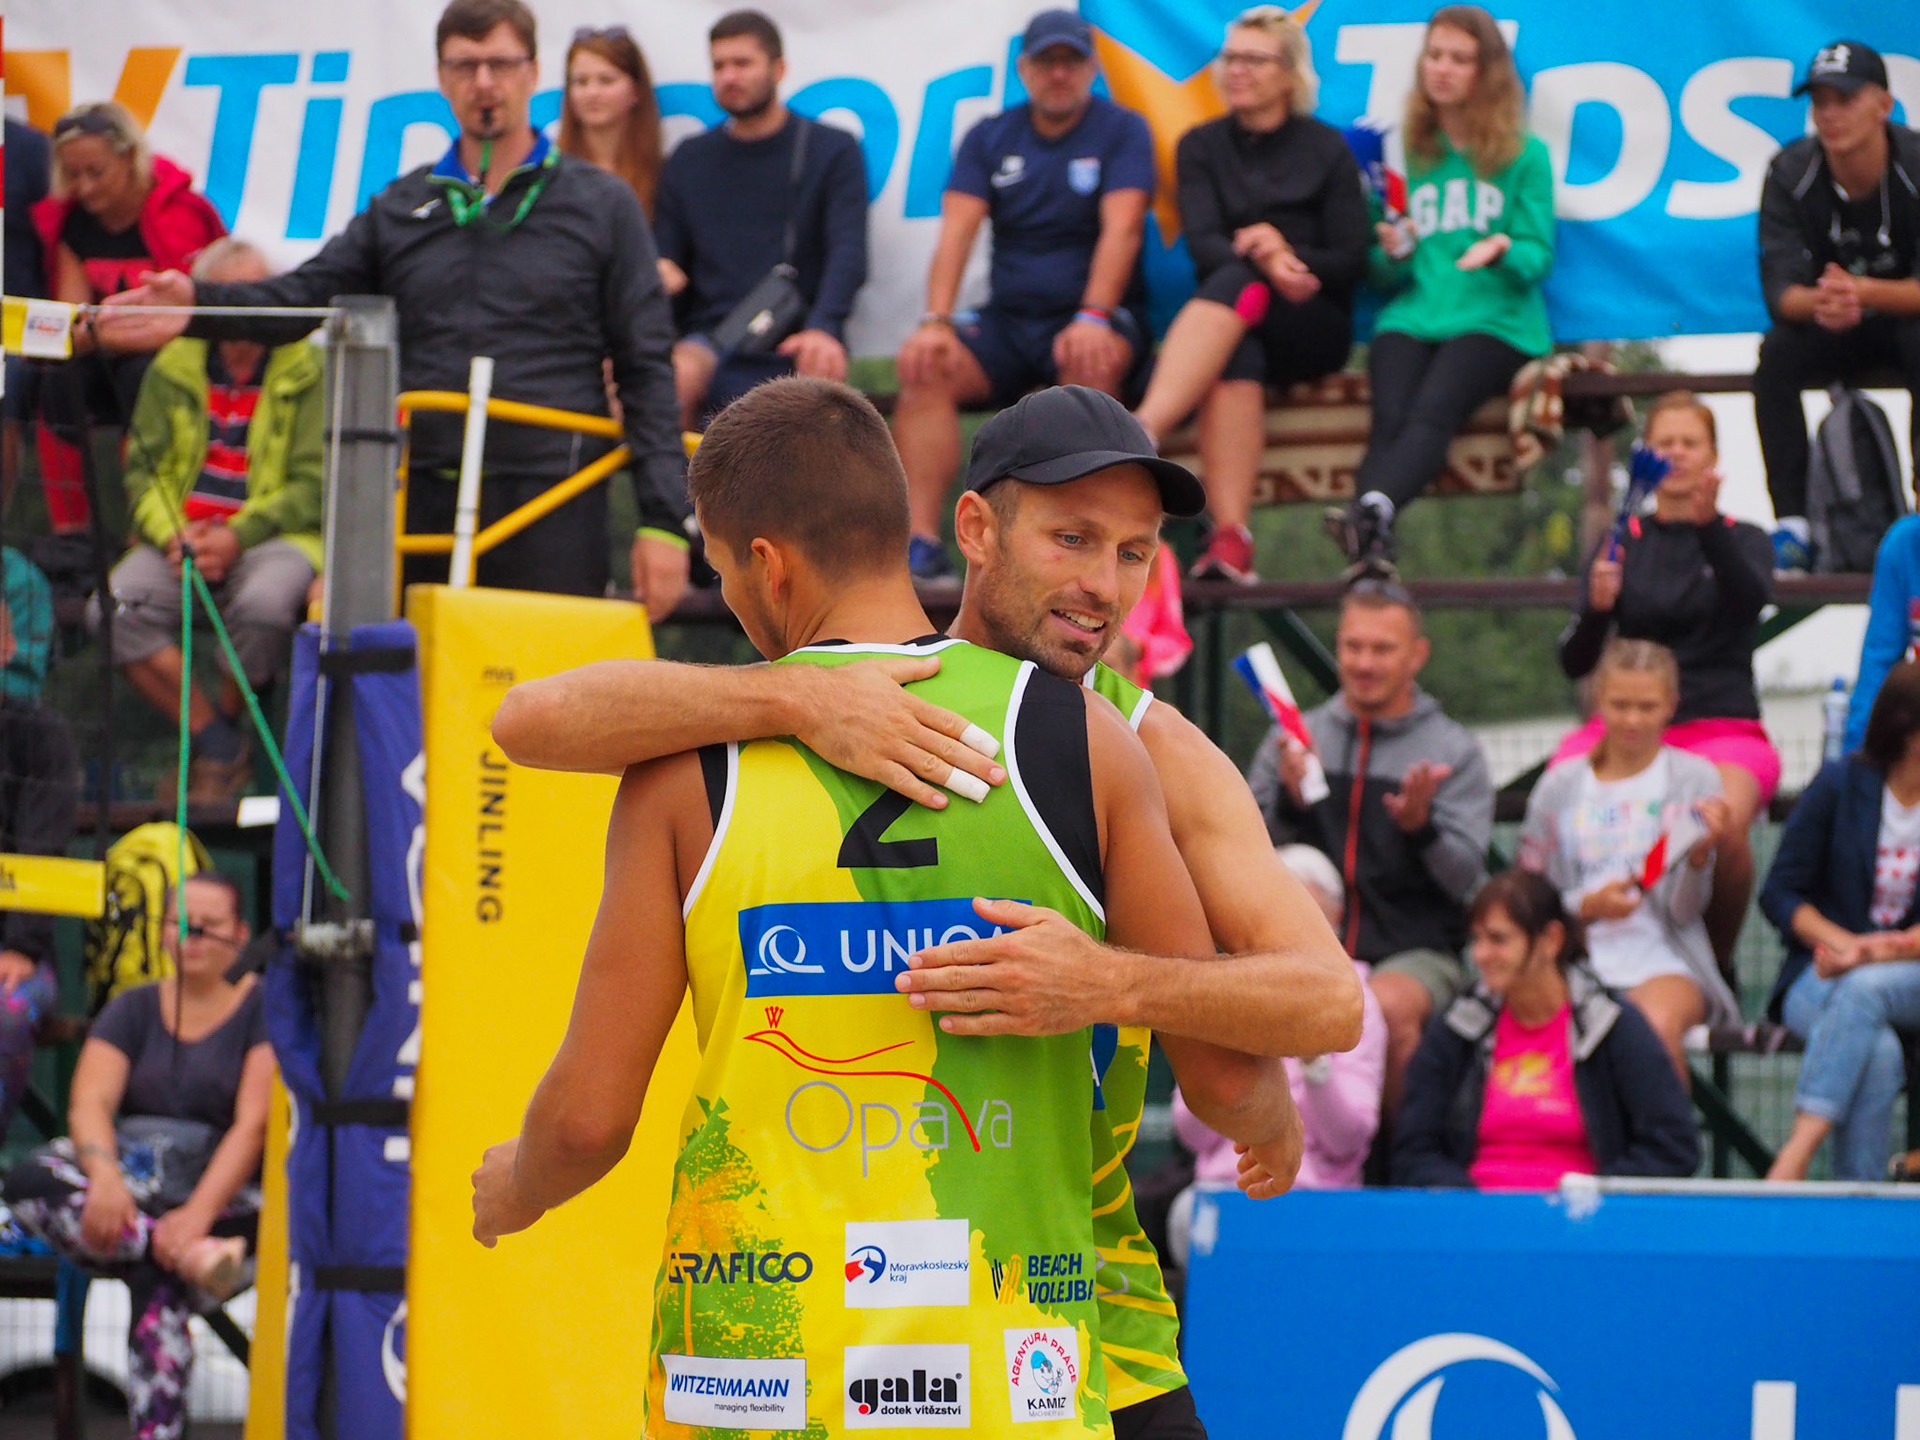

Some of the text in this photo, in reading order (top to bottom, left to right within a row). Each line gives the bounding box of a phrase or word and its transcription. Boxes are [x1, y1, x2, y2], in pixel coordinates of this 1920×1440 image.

[1410, 178, 1505, 239] GAP
[476, 751, 508, 924] JINLING
[785, 1080, 1012, 1178] Opava
[669, 1251, 814, 1285] GRAFICO
[889, 1259, 969, 1273] Moravskoslezský
[1028, 1253, 1082, 1276] BEACH
[889, 1272, 908, 1284] kraj
[1011, 1331, 1048, 1386] AGENTURA
[671, 1373, 790, 1398] WITZENMANN
[714, 1403, 786, 1414] managing flexibility
[881, 1405, 961, 1415] dotek vítězství
[1027, 1397, 1067, 1410] KAMIZ
